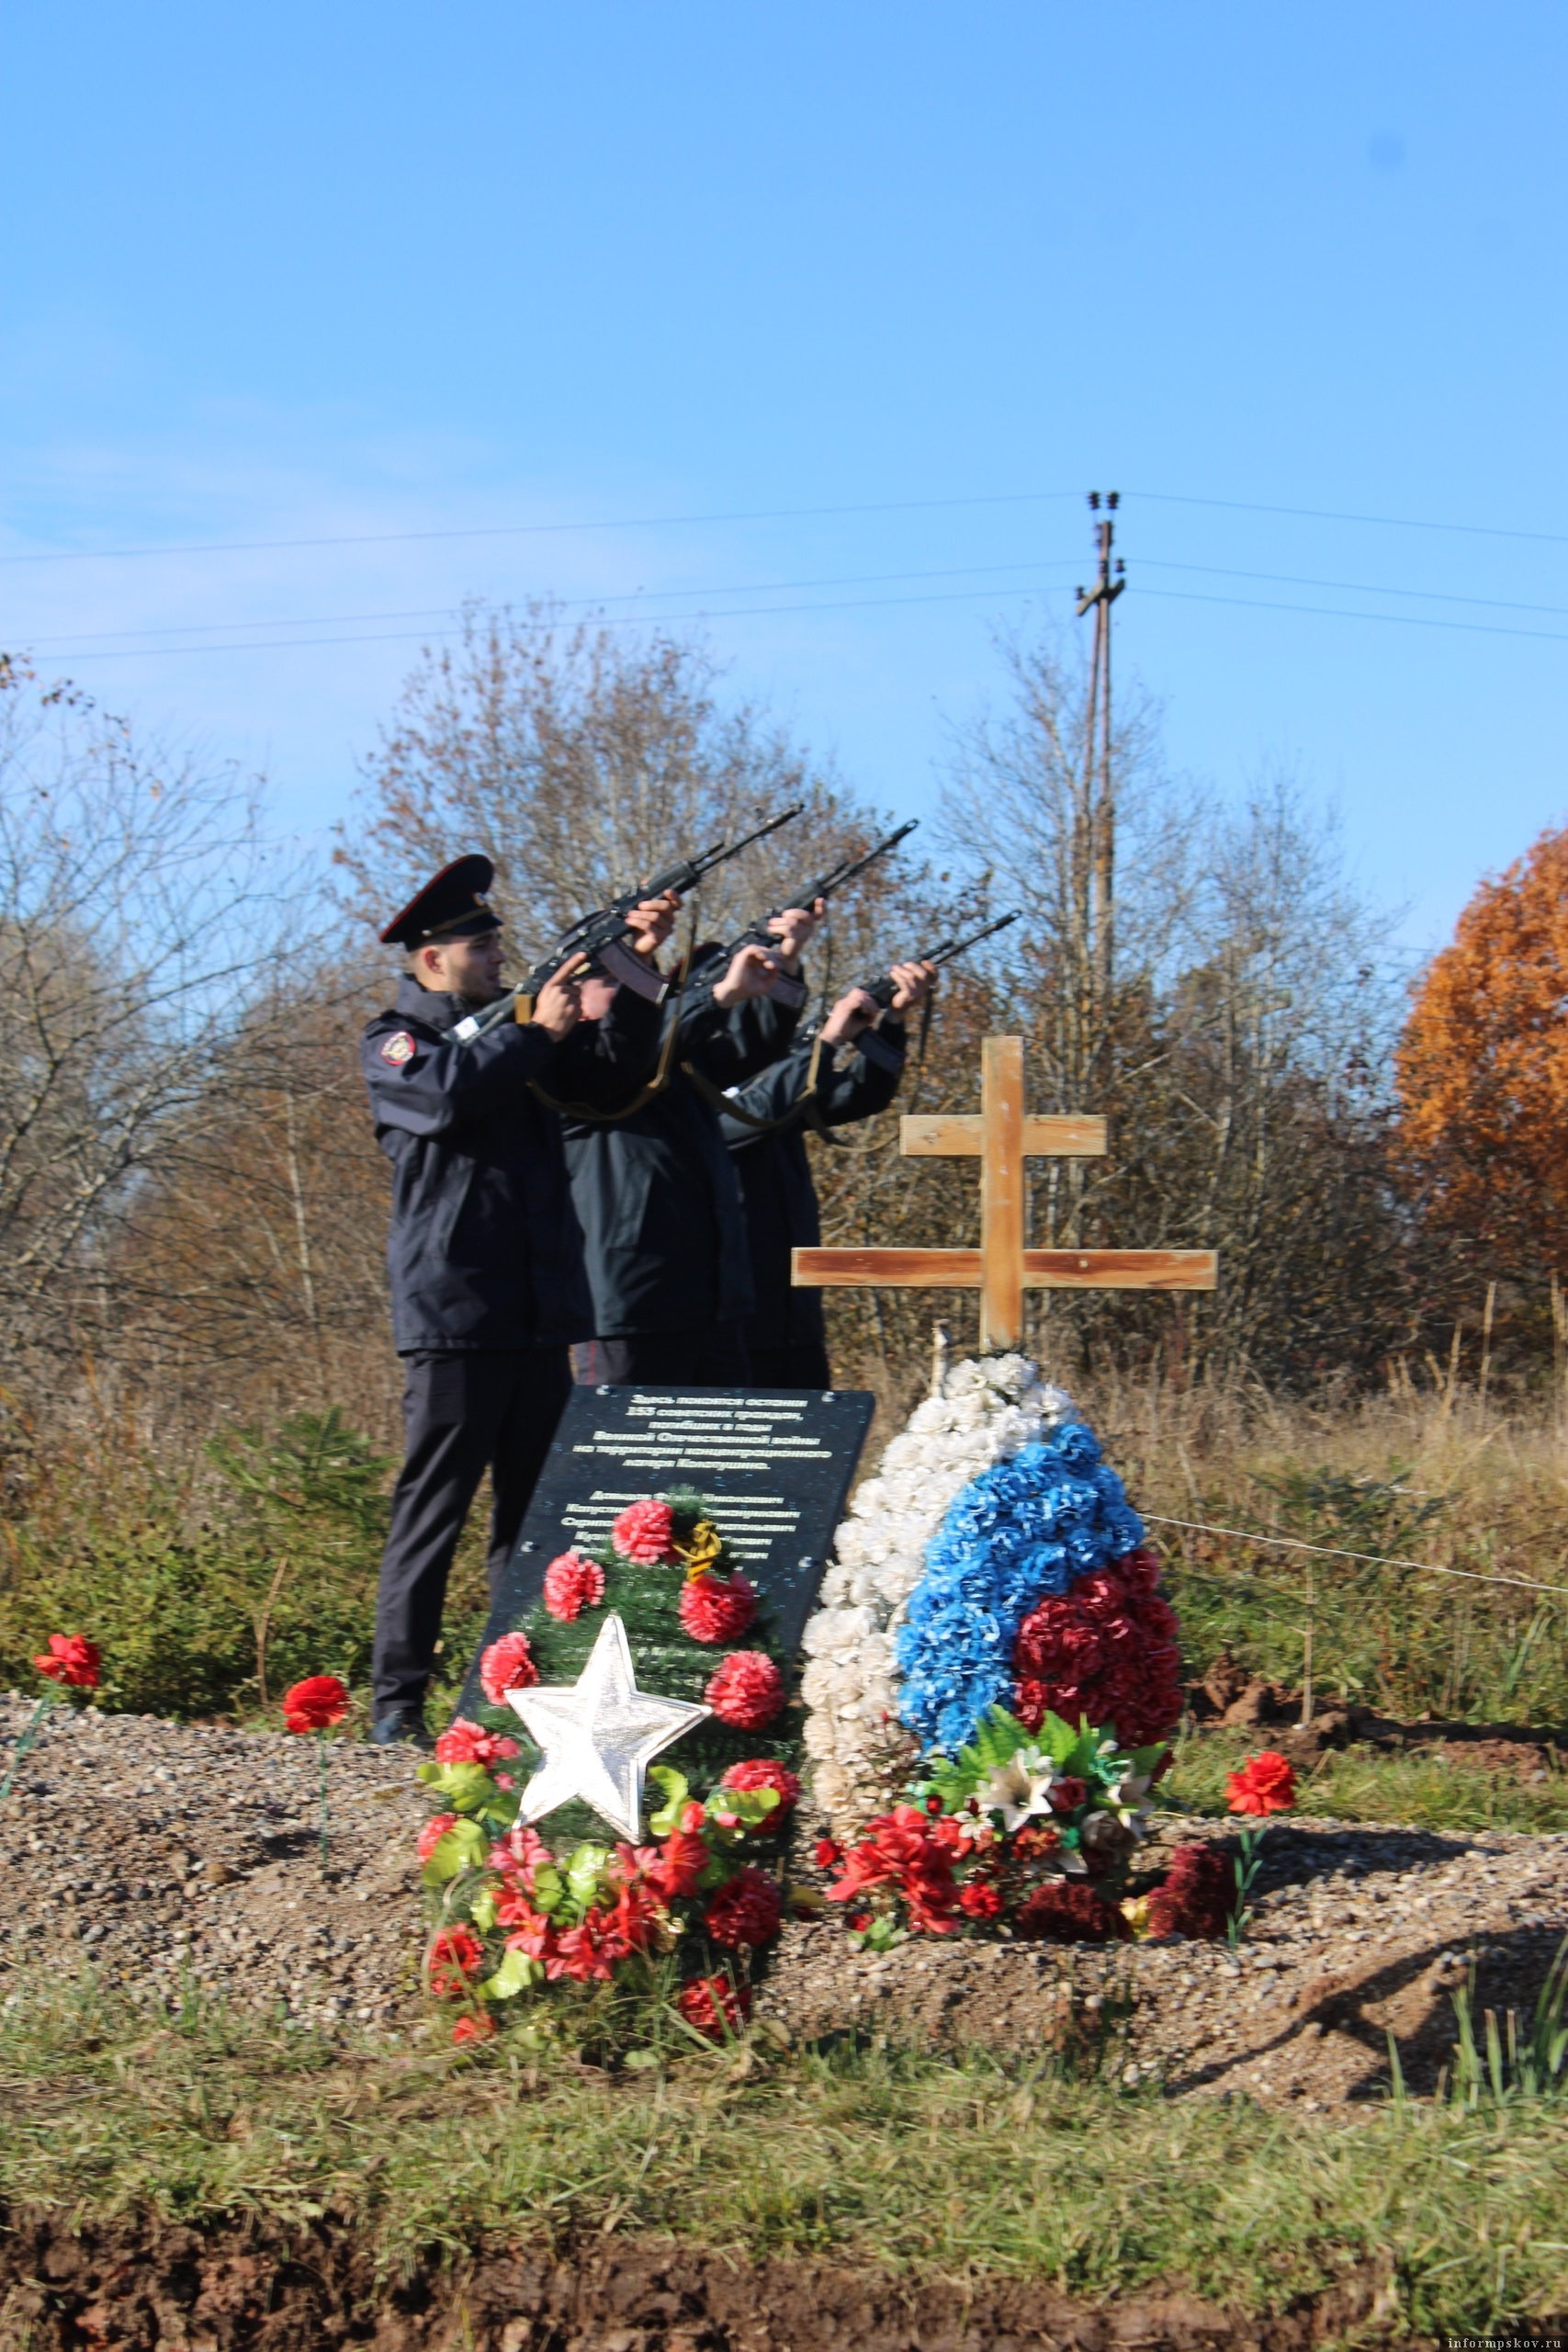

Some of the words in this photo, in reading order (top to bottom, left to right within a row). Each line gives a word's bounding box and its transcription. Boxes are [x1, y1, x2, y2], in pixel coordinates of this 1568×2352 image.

[630, 1394, 675, 1404] Здесь
[676, 1397, 745, 1406] покоятся
[745, 1398, 808, 1407] останки
[656, 1409, 734, 1418] советских
[648, 1419, 721, 1430] погибших
[734, 1423, 773, 1432] годы
[592, 1430, 656, 1442] Великой
[657, 1432, 771, 1444] Отечественной
[771, 1435, 821, 1445] войны
[595, 1445, 683, 1456] территории
[684, 1448, 832, 1459] концентрационного
[622, 1459, 676, 1469] лагеря
